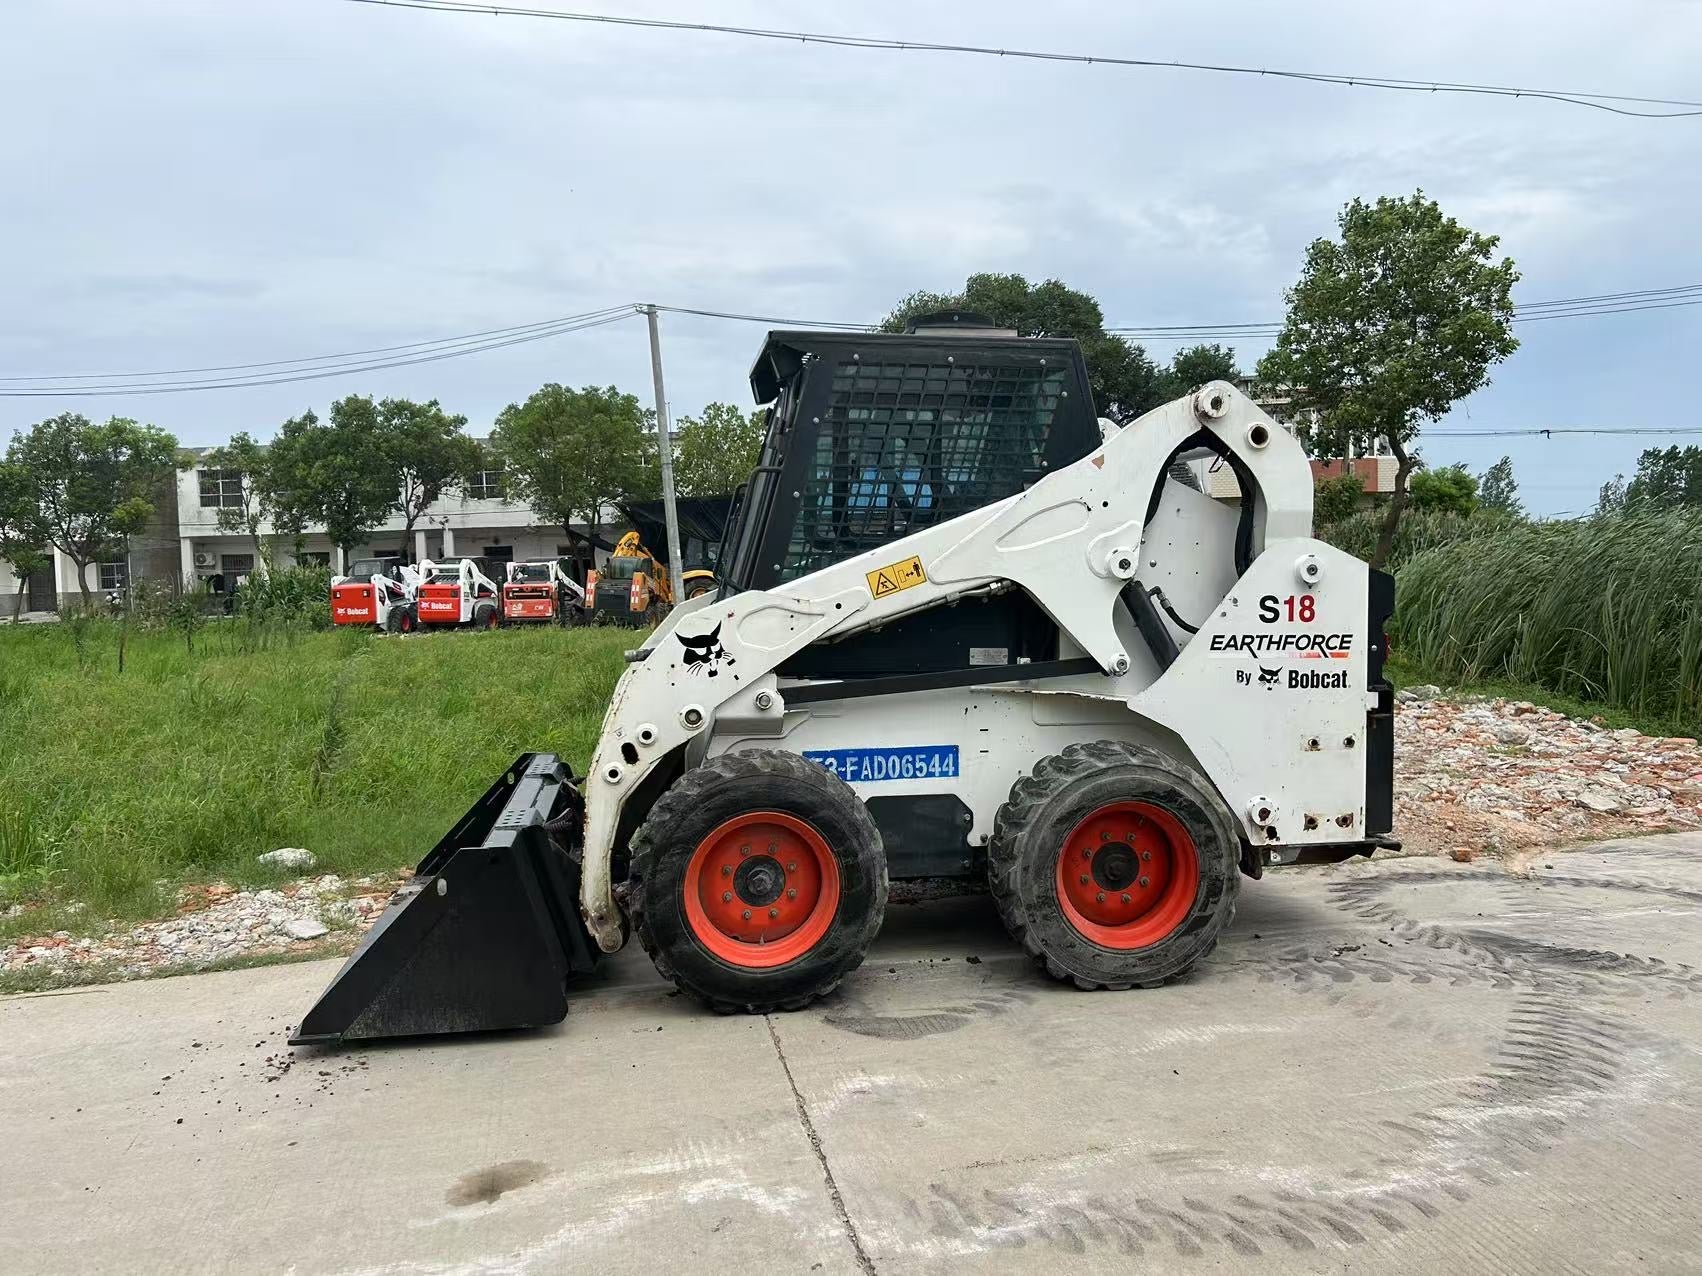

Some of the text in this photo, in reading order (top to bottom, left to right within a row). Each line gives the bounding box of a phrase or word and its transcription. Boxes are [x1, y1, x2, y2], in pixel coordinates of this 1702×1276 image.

[347, 608, 369, 616] Bobcat
[431, 602, 453, 610] Bobcat
[1258, 595, 1315, 623] S18
[1210, 634, 1353, 658] EARTHFORCE
[1236, 670, 1348, 688] By Bobcat
[810, 753, 955, 780] 3-FAD06544
